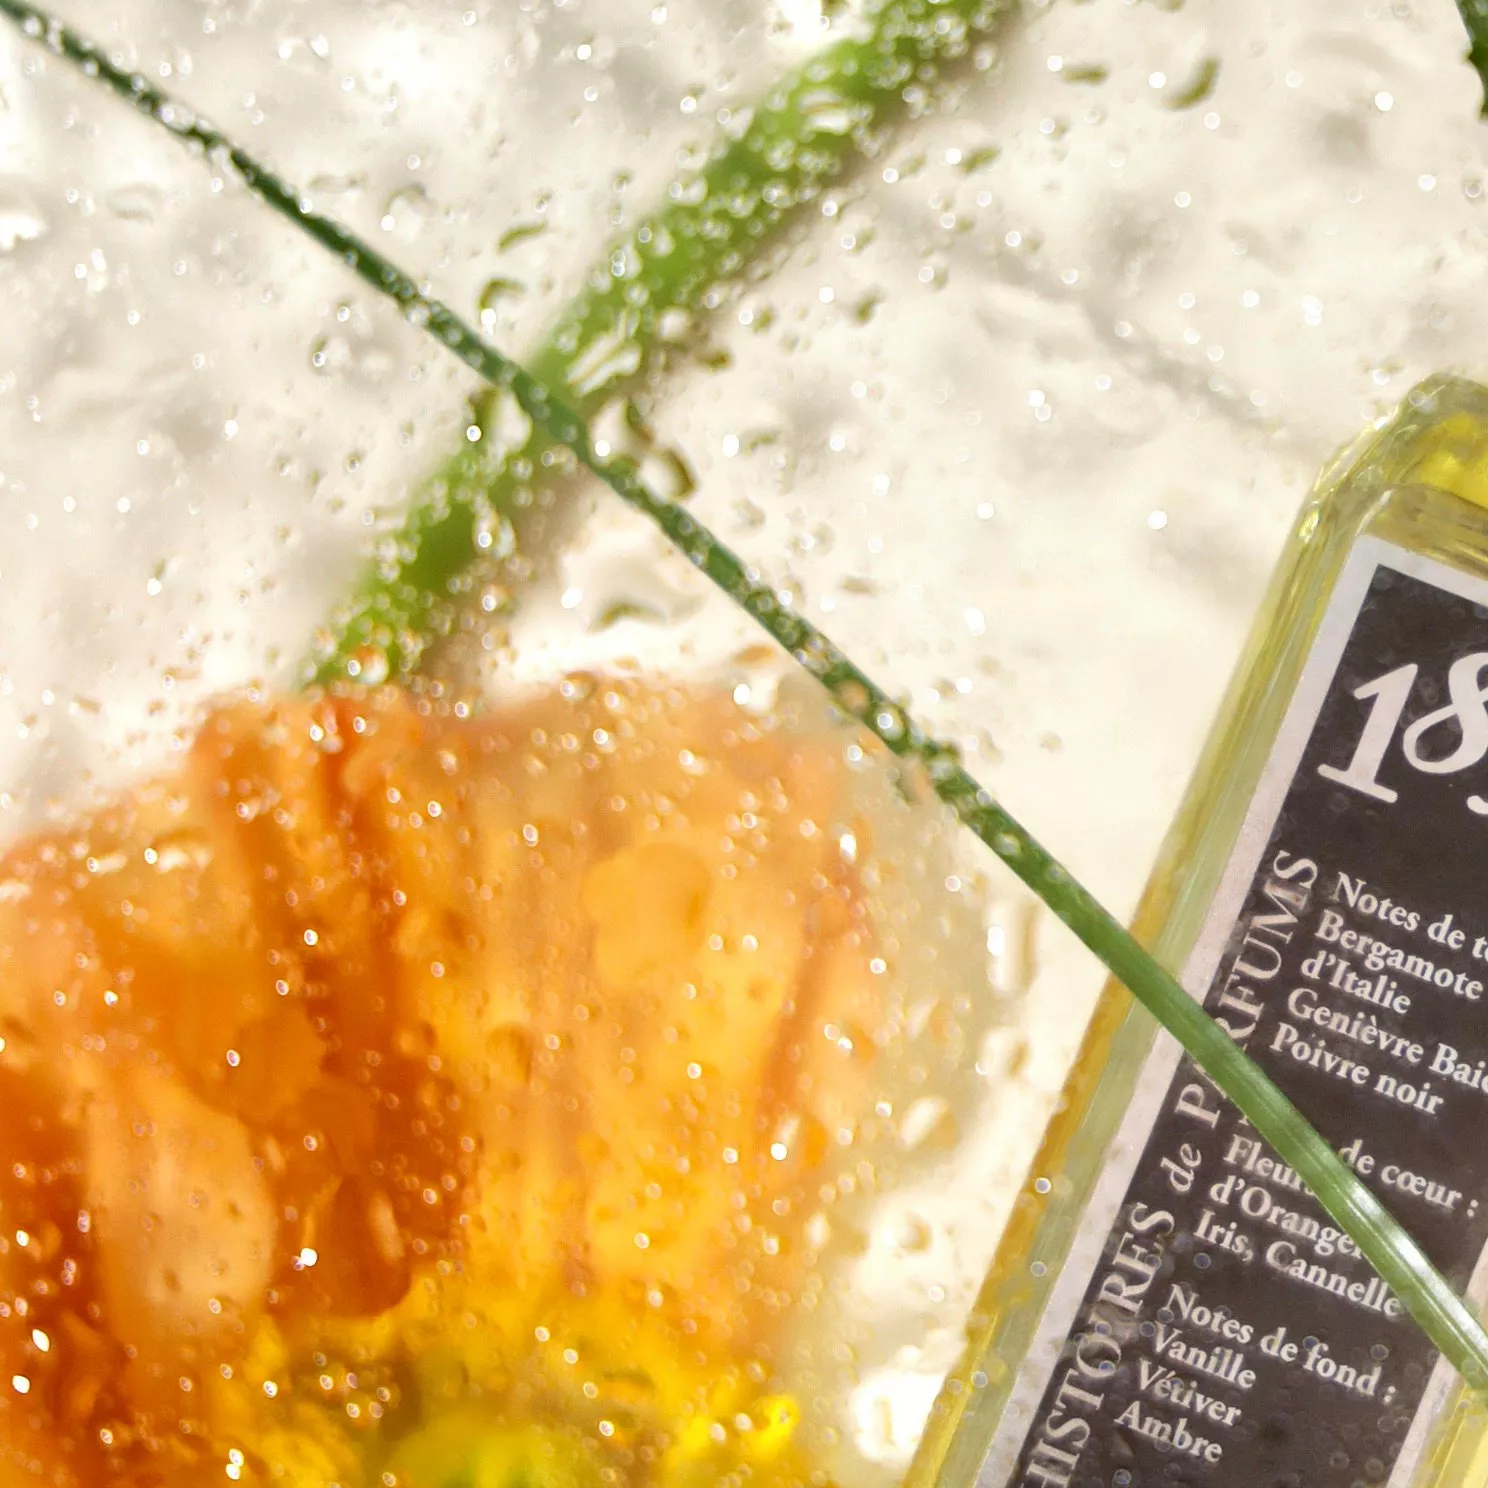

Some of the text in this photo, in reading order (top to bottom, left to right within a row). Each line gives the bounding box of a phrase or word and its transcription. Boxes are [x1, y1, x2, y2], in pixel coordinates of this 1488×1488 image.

[1333, 871, 1420, 932] Notes
[1428, 913, 1467, 950] de
[1315, 910, 1484, 1002] Bergamote
[1287, 987, 1423, 1063] Genièvre
[1269, 1022, 1444, 1117] Poivre noir
[1160, 1143, 1202, 1193] de
[1338, 1139, 1375, 1174] de
[1380, 1164, 1462, 1210] cœur
[1193, 1210, 1402, 1318] Iris, Cannelle
[1149, 1323, 1257, 1389] Vanille
[1167, 1285, 1253, 1344] Notes
[1260, 1327, 1298, 1362] de
[1302, 1342, 1381, 1397] fond
[1136, 1359, 1241, 1427] Vétiver
[1113, 1402, 1223, 1463] Ambre
